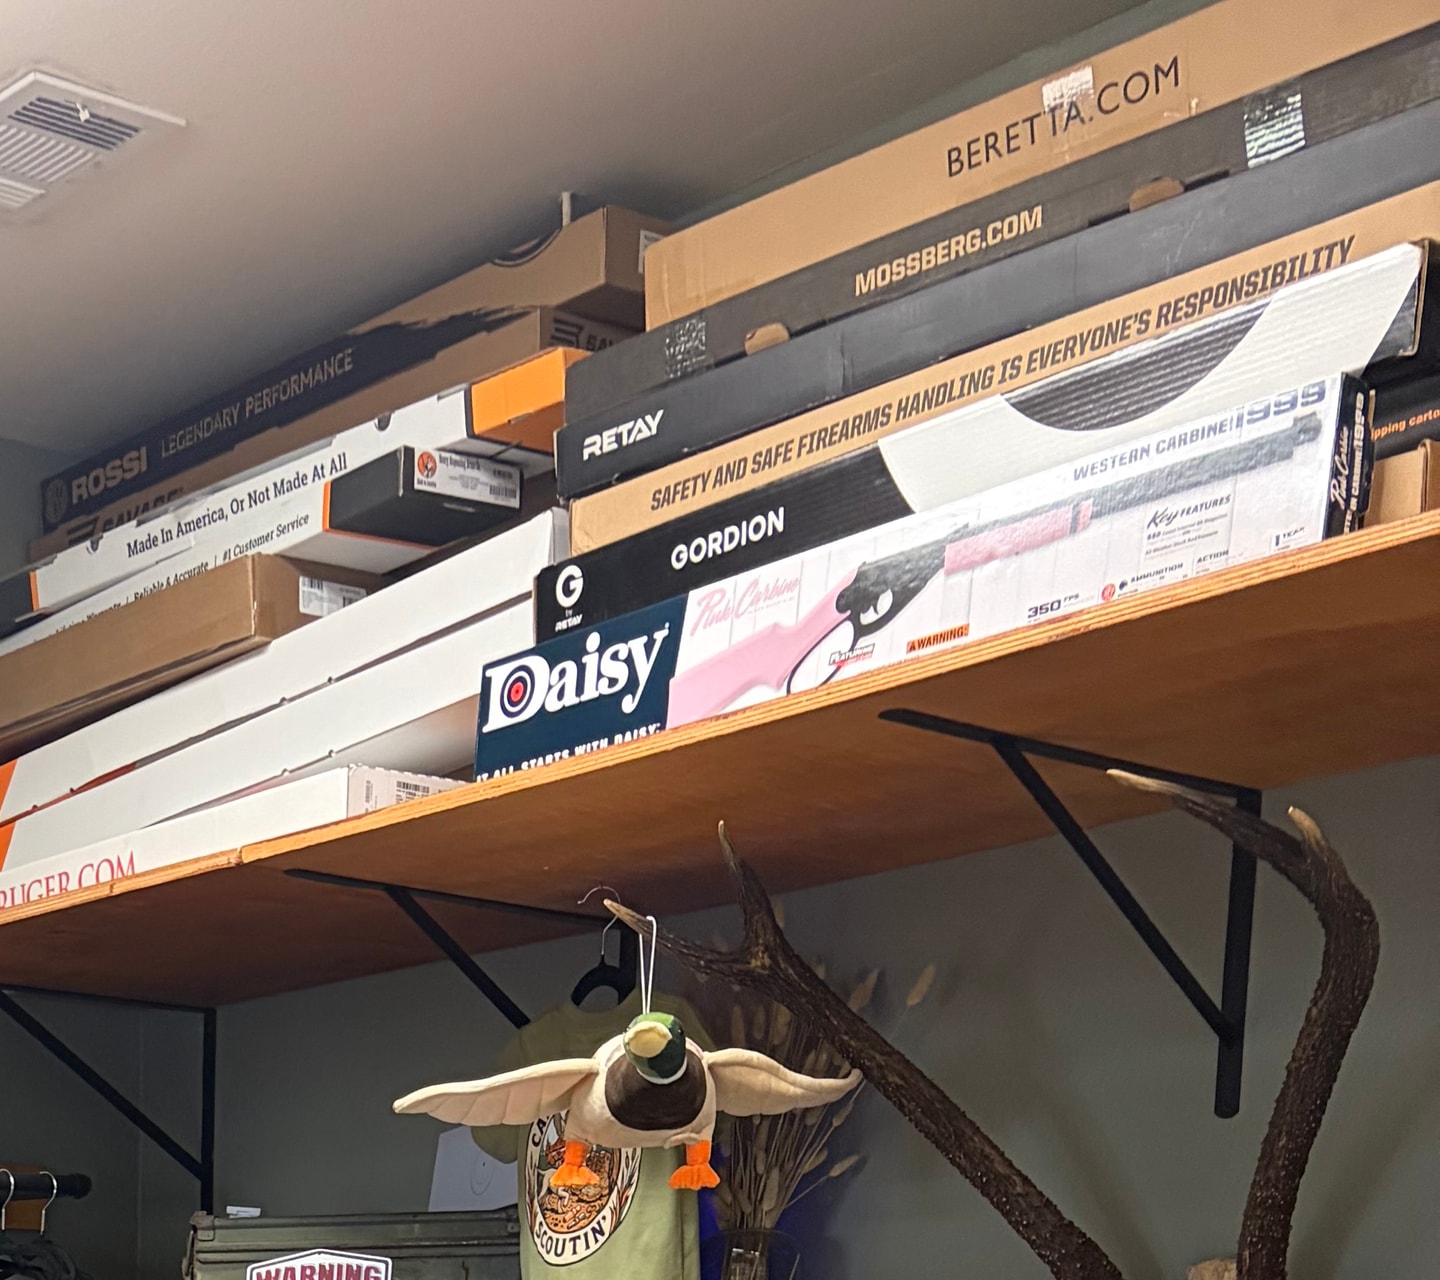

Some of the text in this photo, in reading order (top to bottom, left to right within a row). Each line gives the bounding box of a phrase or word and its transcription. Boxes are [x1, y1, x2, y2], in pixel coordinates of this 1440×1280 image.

[947, 55, 1180, 178] BERETTA.COM
[854, 204, 1044, 297] MOSSBERG.COM
[650, 234, 1356, 512] SAFETY AND SAFE FIREARMS HANDLING IS EVERYONE'S RESPONSIBILITY
[71, 347, 354, 505] ROSSI LEGENDARY PERFORMANCE
[582, 409, 665, 462] RETAY
[1073, 443, 1151, 482] WESTERN
[126, 451, 348, 558] Made In America, Or Not Made At All
[1146, 494, 1232, 530] Key FEATURES
[233, 512, 310, 558] Customer Service
[670, 505, 786, 572] GORDION
[1196, 549, 1230, 565] ACTION
[555, 564, 584, 608] G
[1027, 599, 1061, 620] 350
[555, 613, 583, 633] RETAY
[689, 586, 734, 638] Pink
[481, 624, 670, 733] Daisy
[574, 737, 609, 757] WITH
[534, 1215, 608, 1258] SCOUTIN'
